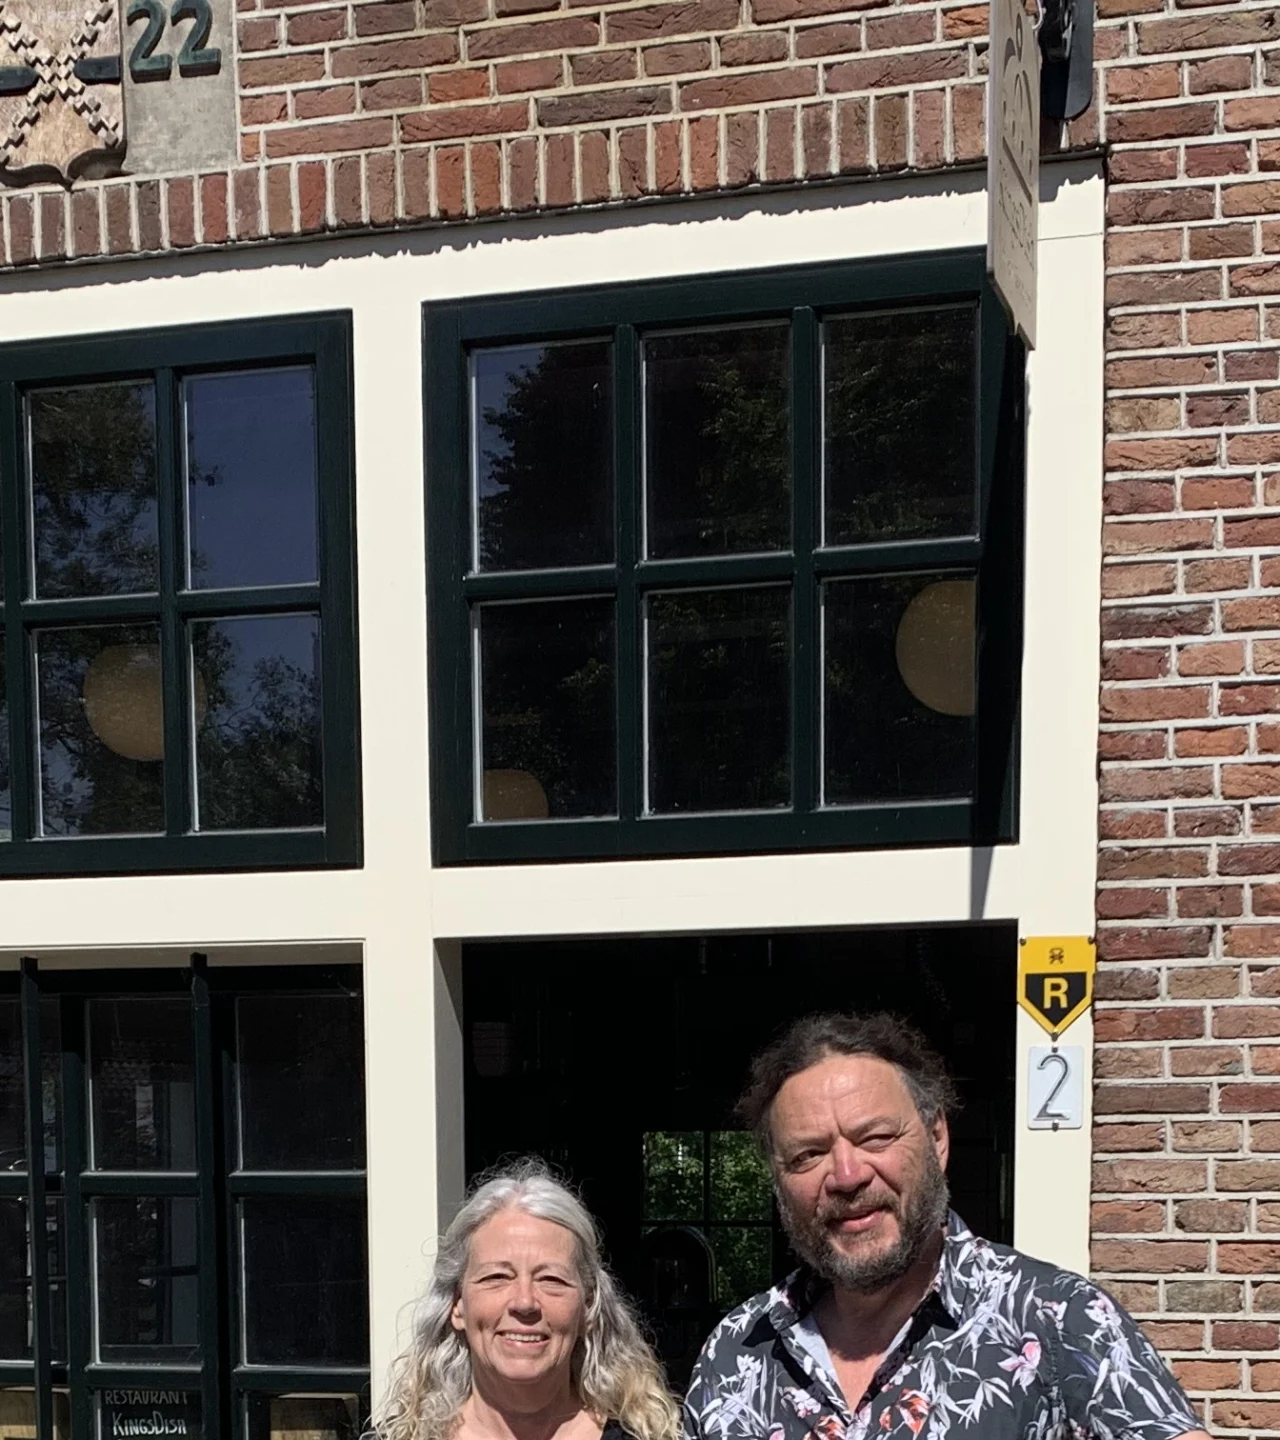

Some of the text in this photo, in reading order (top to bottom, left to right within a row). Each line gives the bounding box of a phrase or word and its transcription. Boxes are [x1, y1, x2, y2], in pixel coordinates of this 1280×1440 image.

[1043, 977, 1069, 1010] R
[1034, 1054, 1070, 1121] 2
[104, 1389, 189, 1405] RESTAURANT
